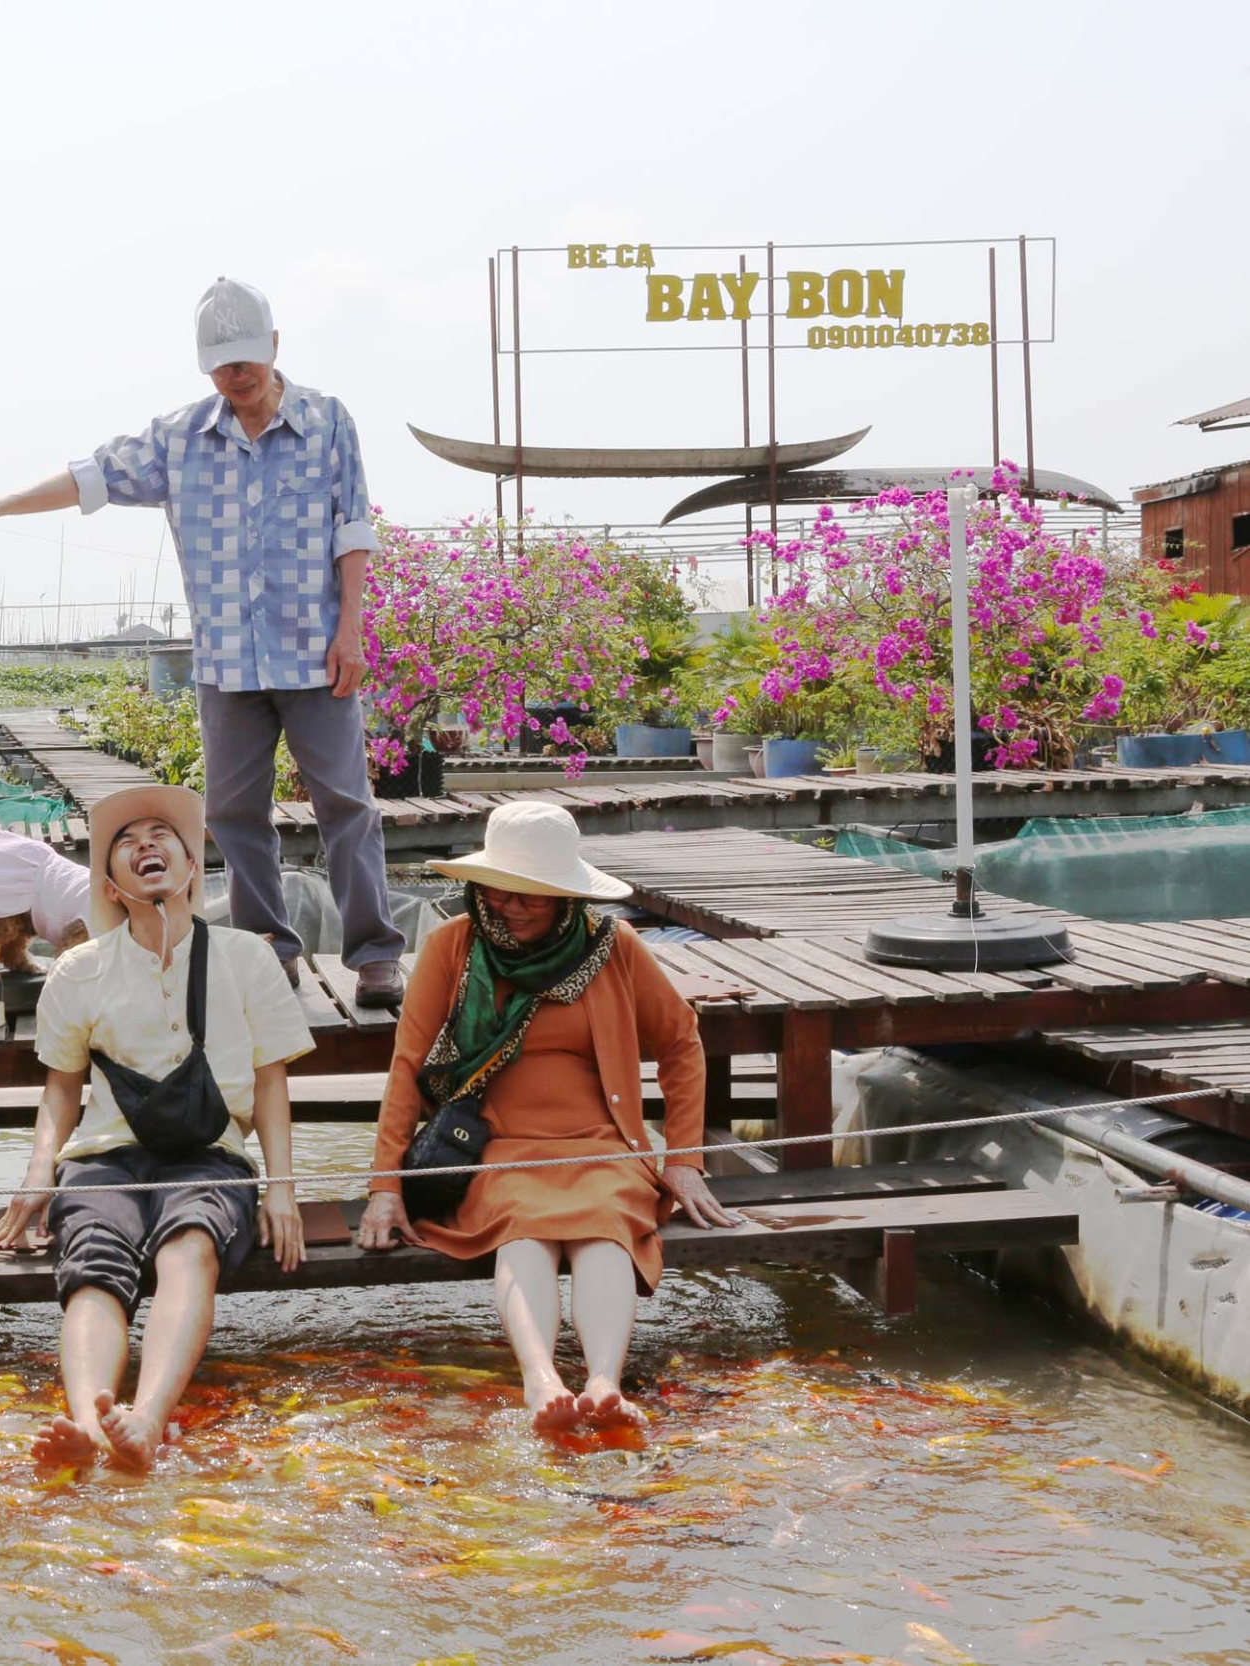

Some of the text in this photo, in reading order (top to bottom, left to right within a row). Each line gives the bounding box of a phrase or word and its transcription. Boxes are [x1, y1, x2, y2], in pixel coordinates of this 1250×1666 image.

[567, 243, 655, 269] BE CA
[646, 269, 906, 322] BAY BON
[807, 322, 990, 349] 0901040738
